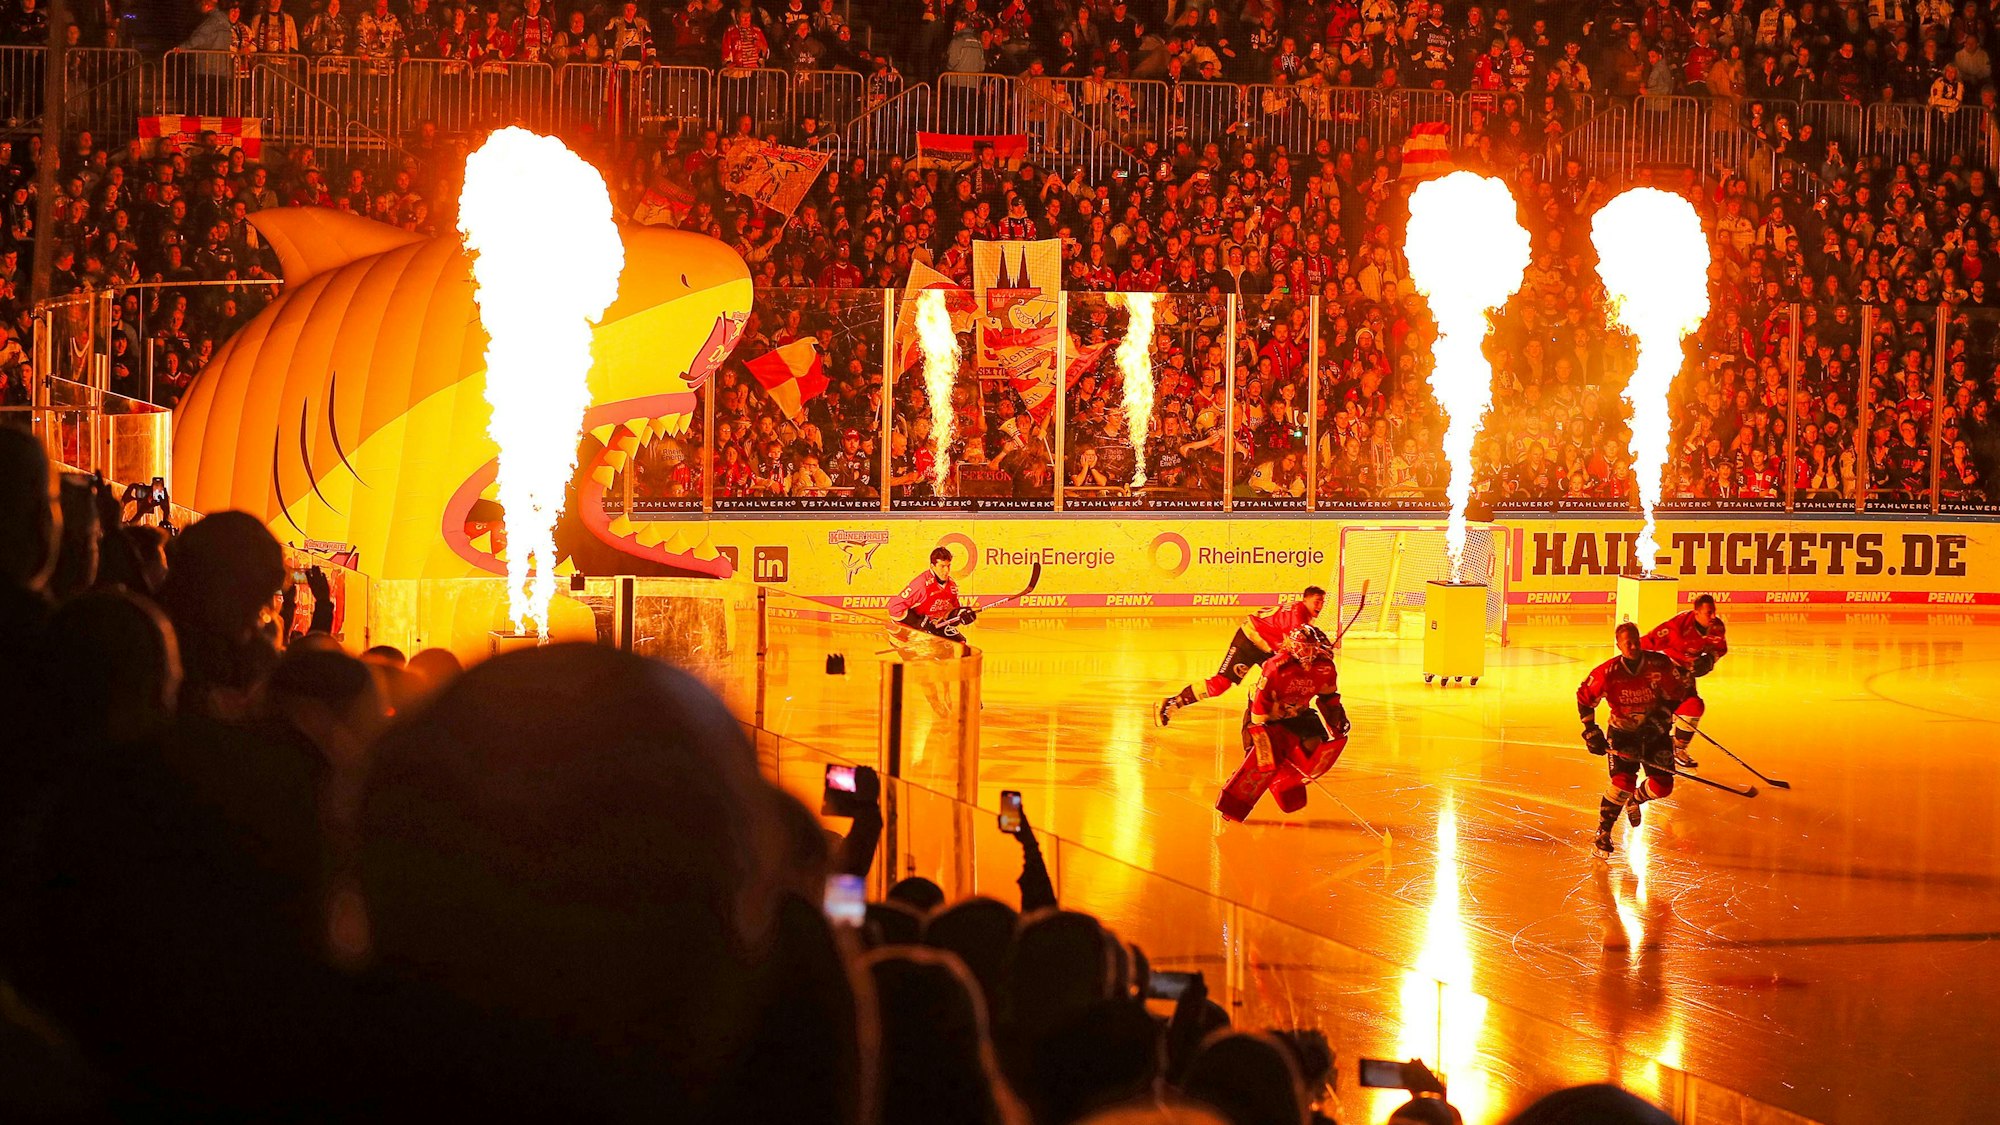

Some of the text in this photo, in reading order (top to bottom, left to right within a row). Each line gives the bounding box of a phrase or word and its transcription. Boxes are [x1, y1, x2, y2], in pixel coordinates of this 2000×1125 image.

[1867, 502, 1929, 510] STAHLWERK
[1941, 503, 2000, 512] STAHLWER
[986, 548, 1115, 566] RheinEnergie
[1199, 547, 1324, 567] RheinEnergie
[758, 551, 784, 578] in
[901, 587, 912, 598] 5
[1527, 592, 1573, 604] PENNY.
[1765, 592, 1810, 603] PENNY.
[1846, 592, 1892, 603] PENNY.
[1928, 592, 1976, 604] PENNY.
[1020, 595, 1068, 607] PENNY.
[1106, 595, 1154, 606] PENNY.
[1193, 595, 1240, 606] PENNY.
[1278, 593, 1304, 604] PEN
